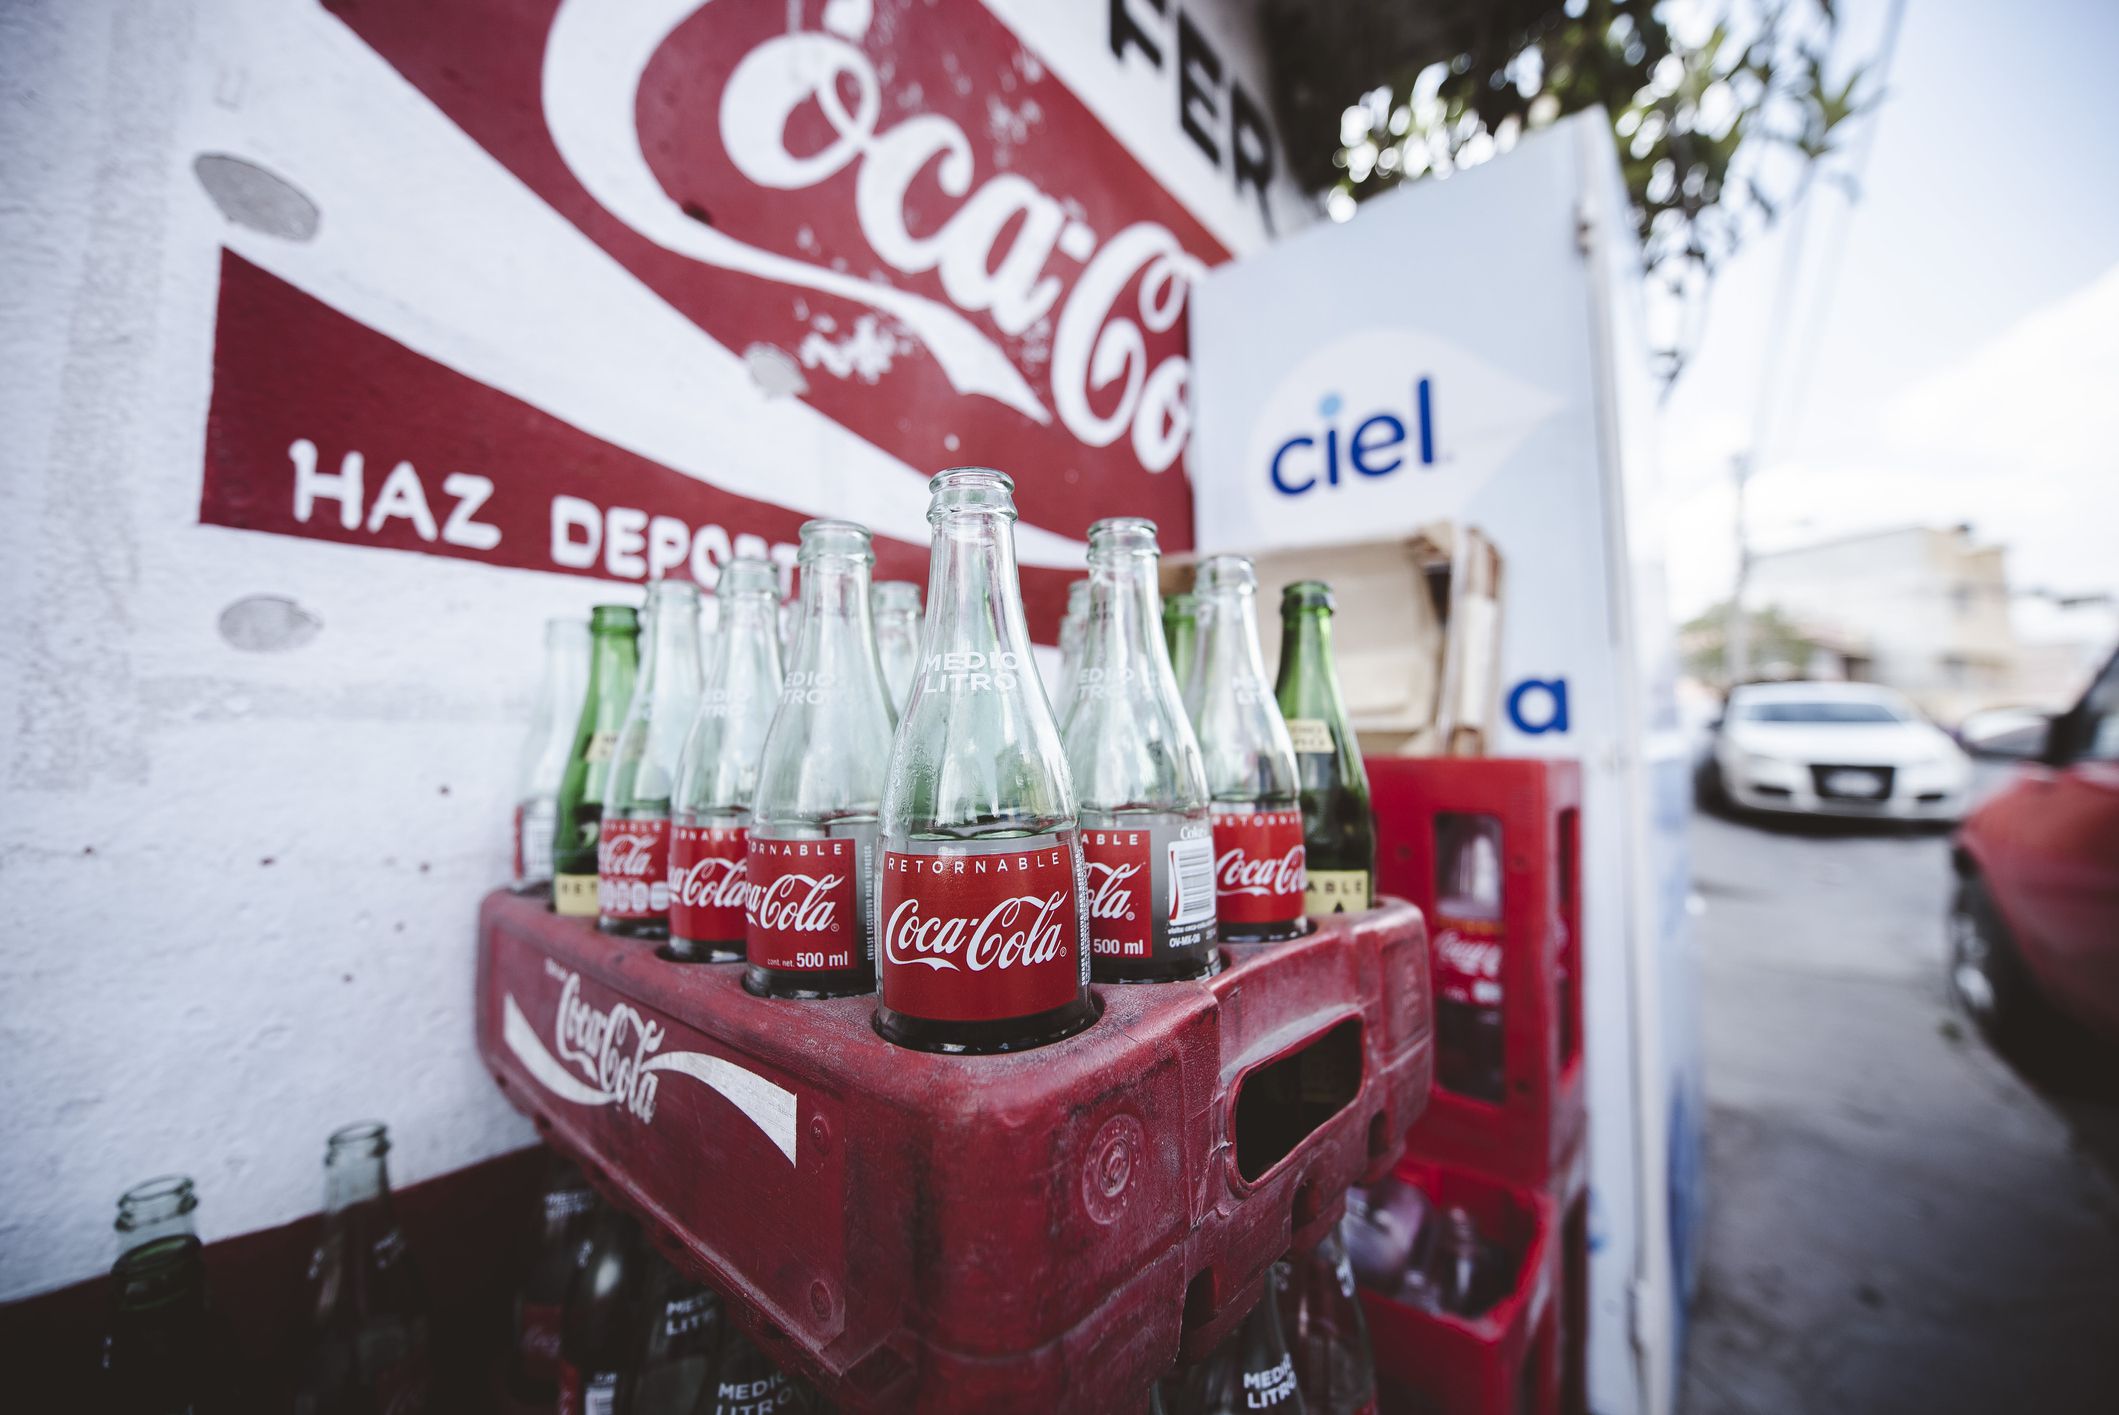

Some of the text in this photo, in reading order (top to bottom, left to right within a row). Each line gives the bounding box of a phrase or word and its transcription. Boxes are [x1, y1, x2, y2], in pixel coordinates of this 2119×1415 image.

[1271, 379, 1433, 496] ciel
[288, 438, 502, 551] HAZ
[924, 652, 1020, 671] MEDIO
[923, 672, 1017, 693] LITRO
[747, 842, 842, 857] ORNABLE
[888, 852, 1060, 875] RETORNABLE
[885, 889, 1069, 973] Coca-Cola
[1093, 938, 1144, 955] 500 ml
[796, 952, 824, 968] 500
[828, 951, 848, 967] ml
